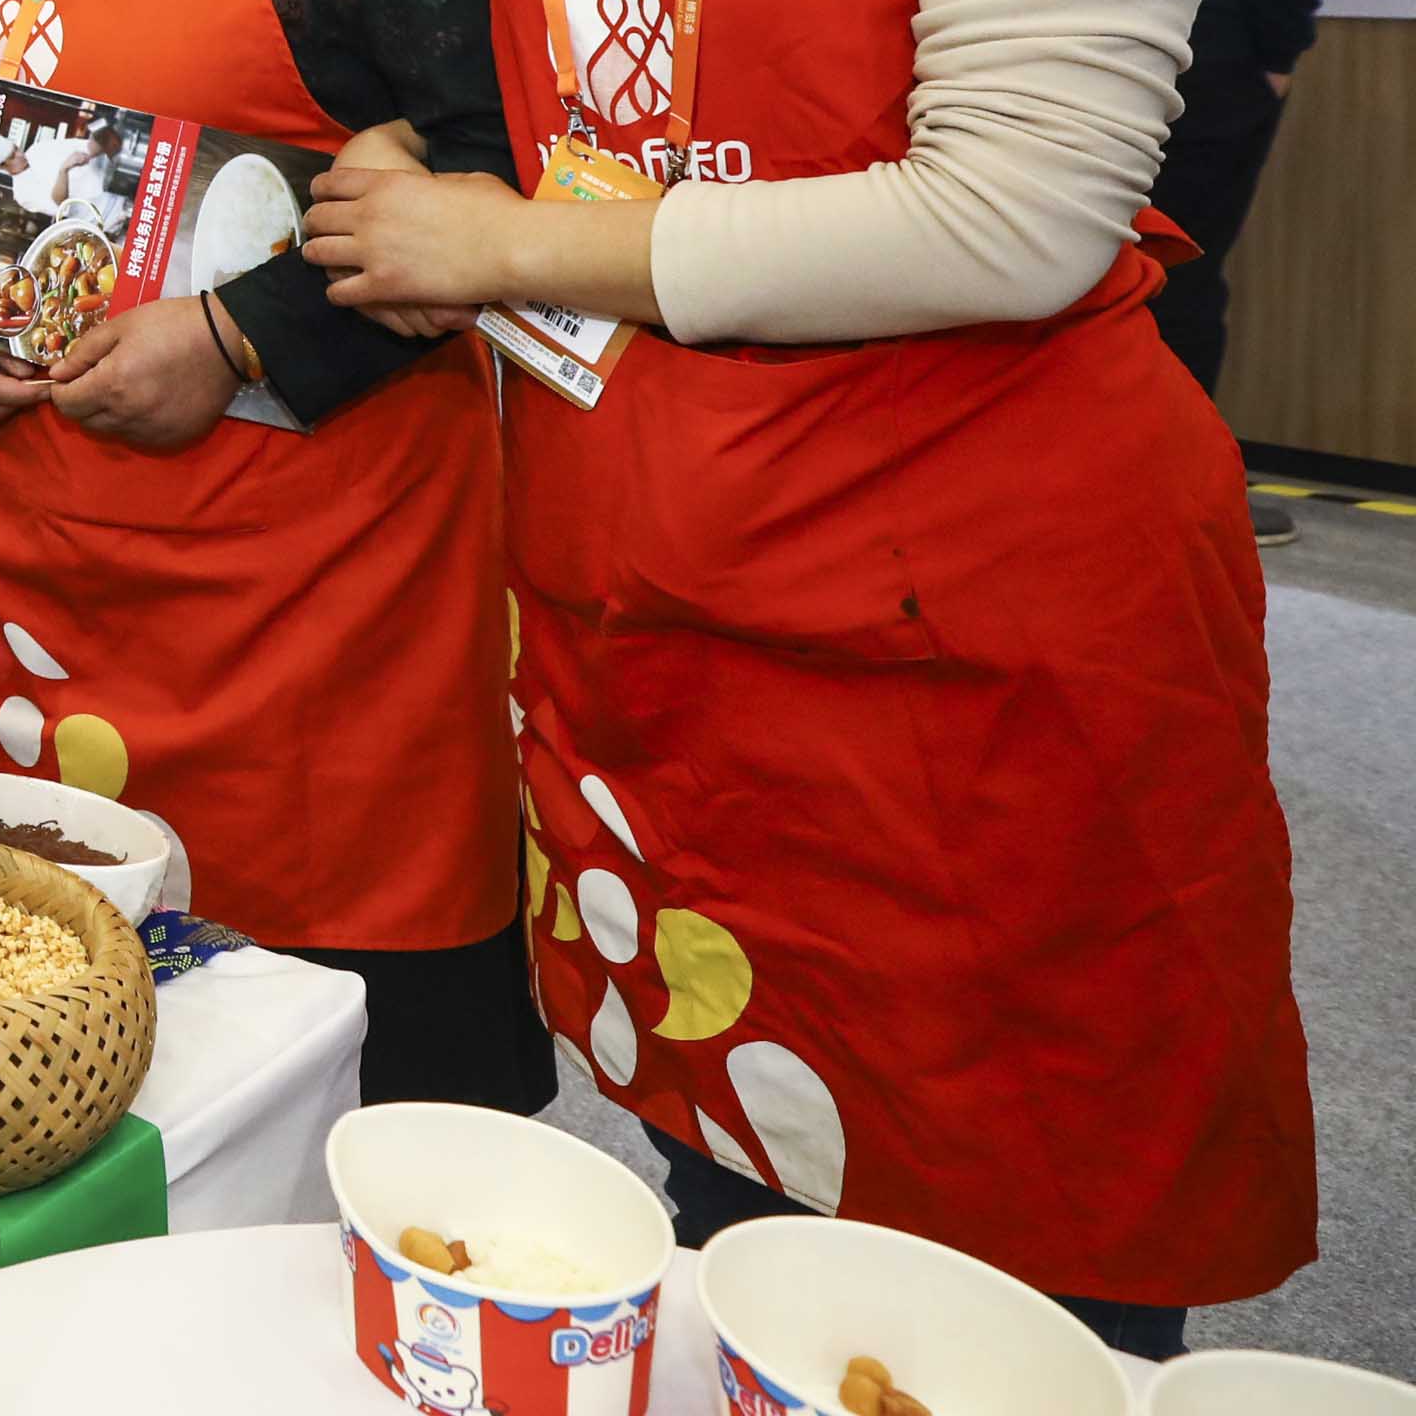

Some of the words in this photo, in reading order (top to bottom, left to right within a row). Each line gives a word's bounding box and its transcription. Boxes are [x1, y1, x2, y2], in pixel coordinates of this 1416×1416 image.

[125, 140, 173, 279] 好侍业务用产品宣传册
